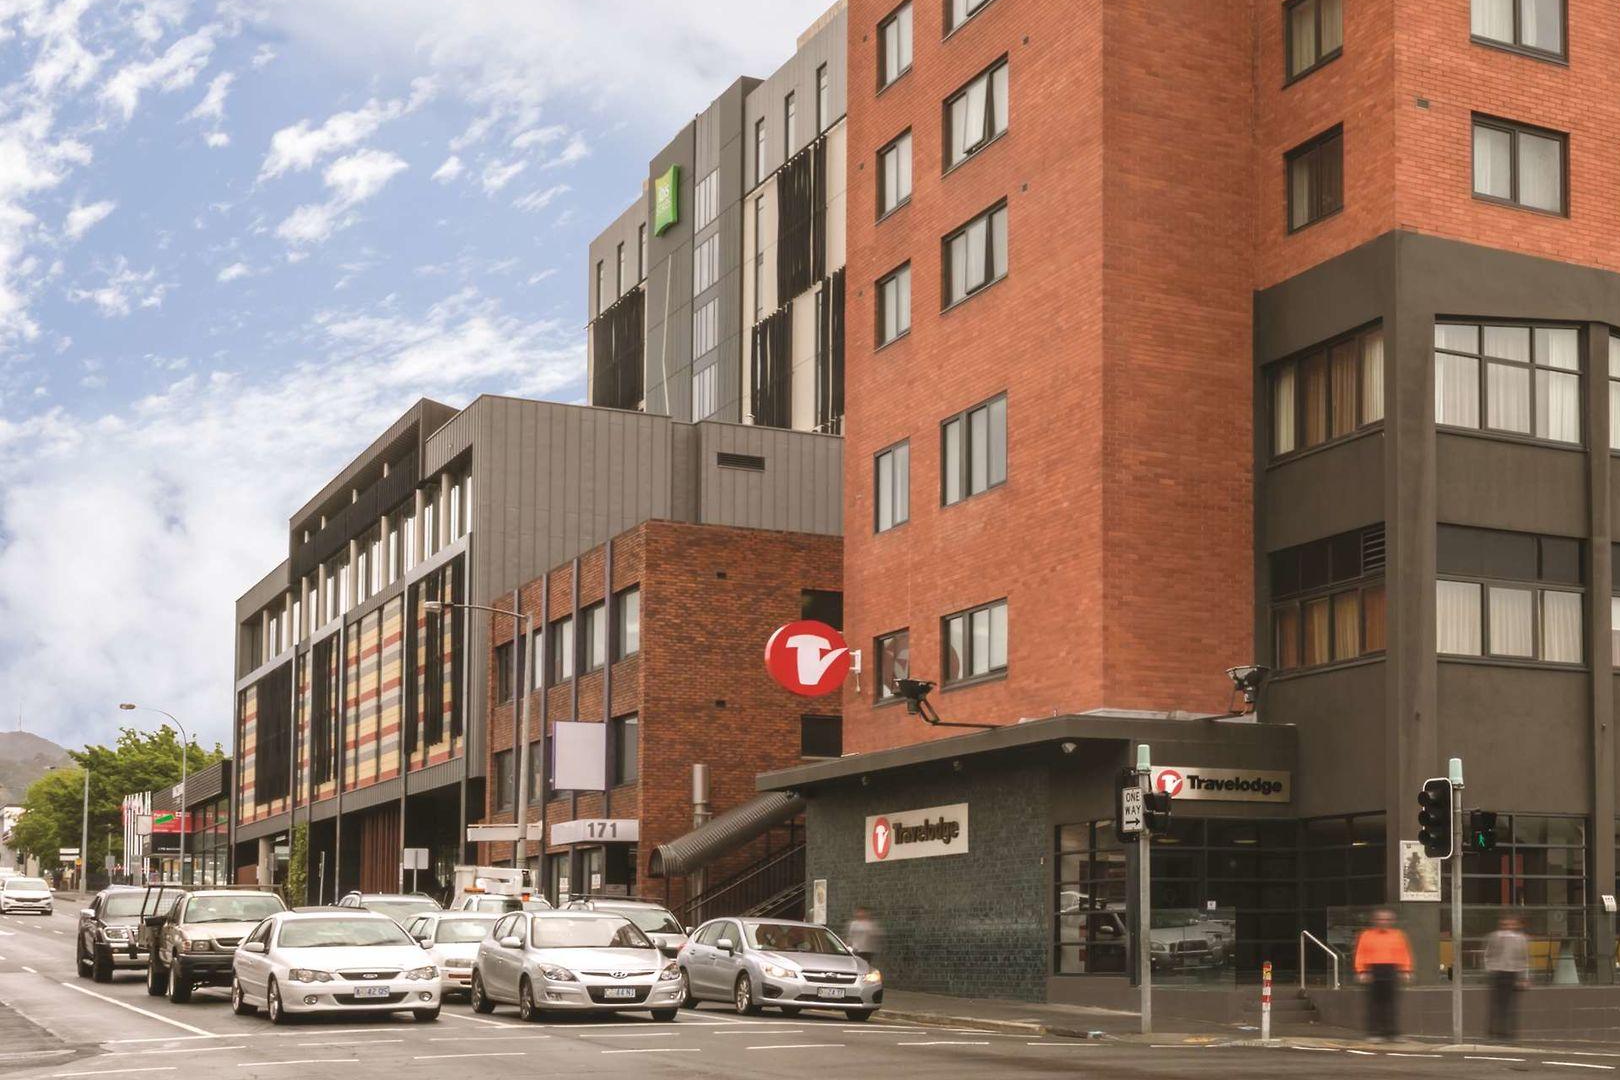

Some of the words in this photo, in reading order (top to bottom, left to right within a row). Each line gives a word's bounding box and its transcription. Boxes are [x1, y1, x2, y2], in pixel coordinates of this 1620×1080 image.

[1187, 775, 1282, 795] Travelodge
[1125, 792, 1140, 802] ONE
[1125, 806, 1141, 815] WAY
[587, 823, 617, 838] 171
[892, 816, 960, 845] Travelodge
